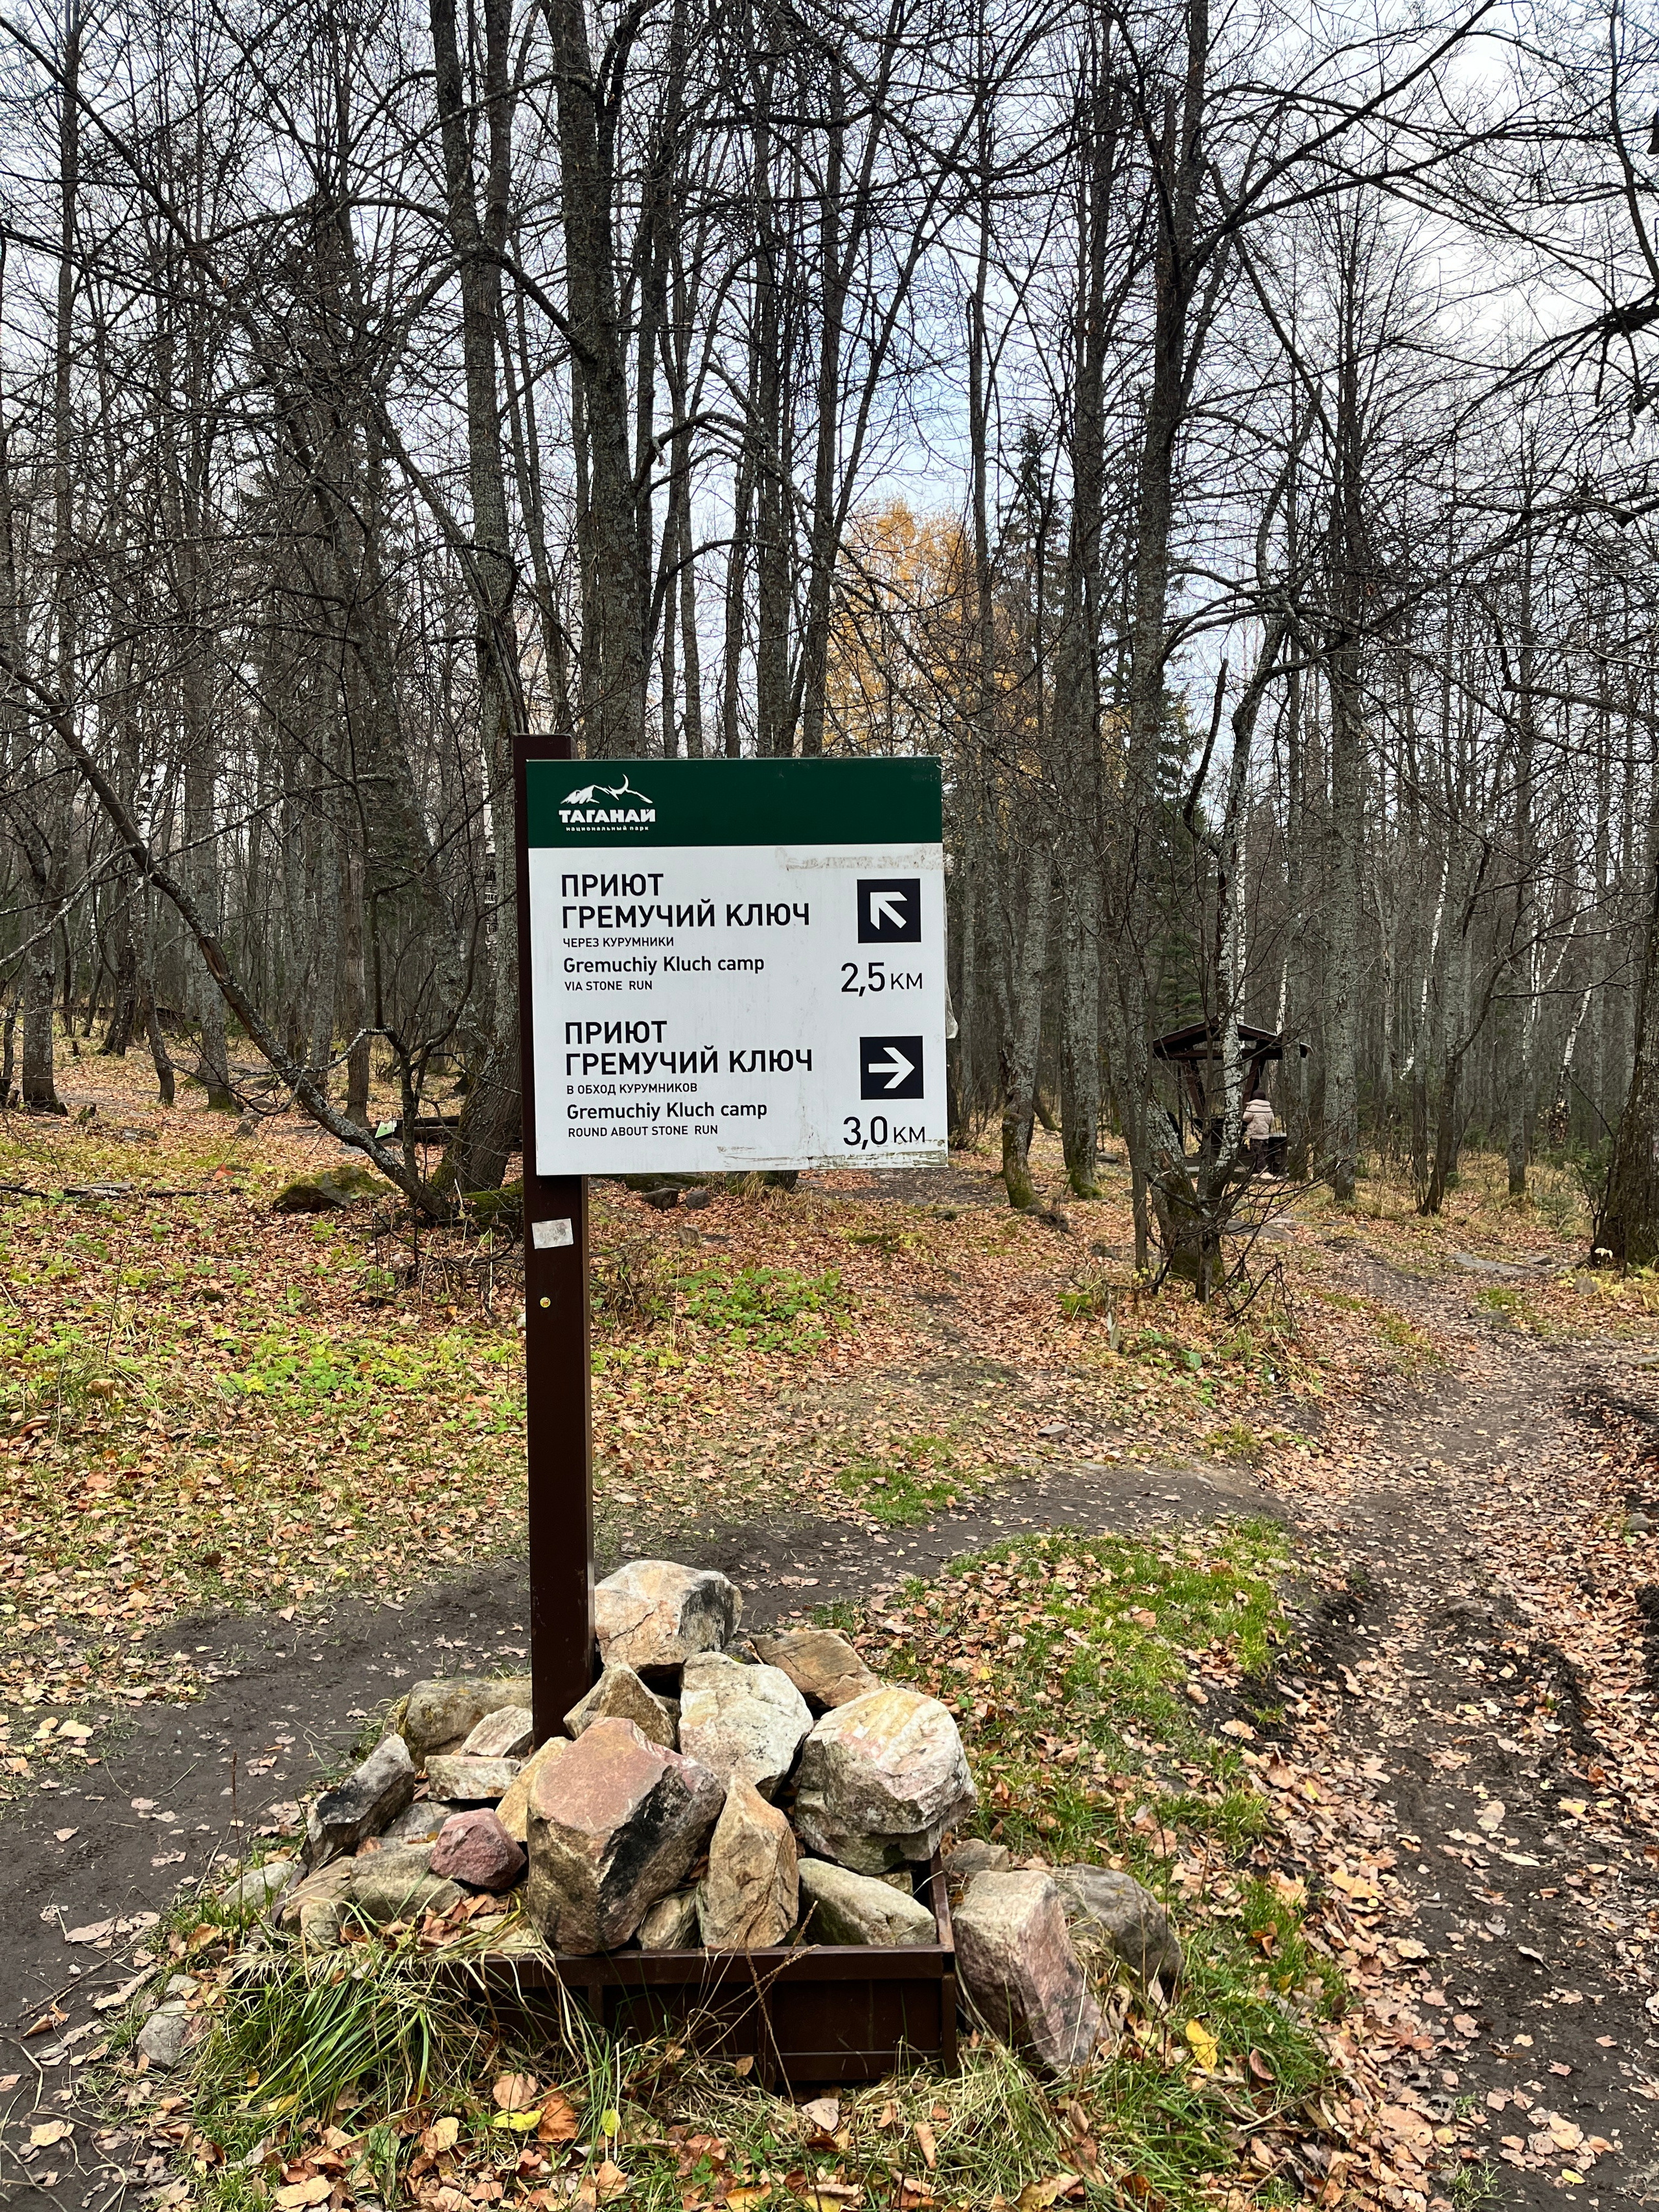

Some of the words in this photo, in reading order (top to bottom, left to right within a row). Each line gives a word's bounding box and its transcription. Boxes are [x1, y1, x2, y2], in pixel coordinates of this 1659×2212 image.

[559, 809, 656, 823] ТАГАНАЙ
[561, 873, 664, 897] ПРИЮТ
[563, 898, 715, 929] ГРЕМУЧИЙ
[726, 903, 810, 927] КЛЮЧ
[563, 937, 599, 948] ЧЕРЕЗ
[603, 937, 675, 948] КУРУМНИКИ
[563, 956, 658, 976] Gremuchiy
[663, 955, 712, 972] Kluch
[717, 958, 765, 974] camp
[564, 981, 583, 992] VIA
[586, 981, 623, 991] STONE
[629, 980, 653, 990] RUN
[841, 962, 886, 997] 2,5
[565, 1020, 667, 1045] ПРИЮТ
[566, 1045, 719, 1076] ГРЕМУЧИЙ
[729, 1049, 813, 1073] КЛЮЧ
[566, 1085, 574, 1095] В
[577, 1084, 616, 1096] ОБХОД
[619, 1082, 698, 1094] КУРУМНИКОВ
[567, 1102, 661, 1122] Gremuchiy
[666, 1101, 714, 1117] Kluch
[721, 1104, 767, 1120] camp
[568, 1127, 608, 1137] ROUND
[610, 1126, 649, 1137] ABOUT
[651, 1125, 689, 1135] STONE
[694, 1124, 718, 1135] RUN
[843, 1115, 888, 1150] 3,0
